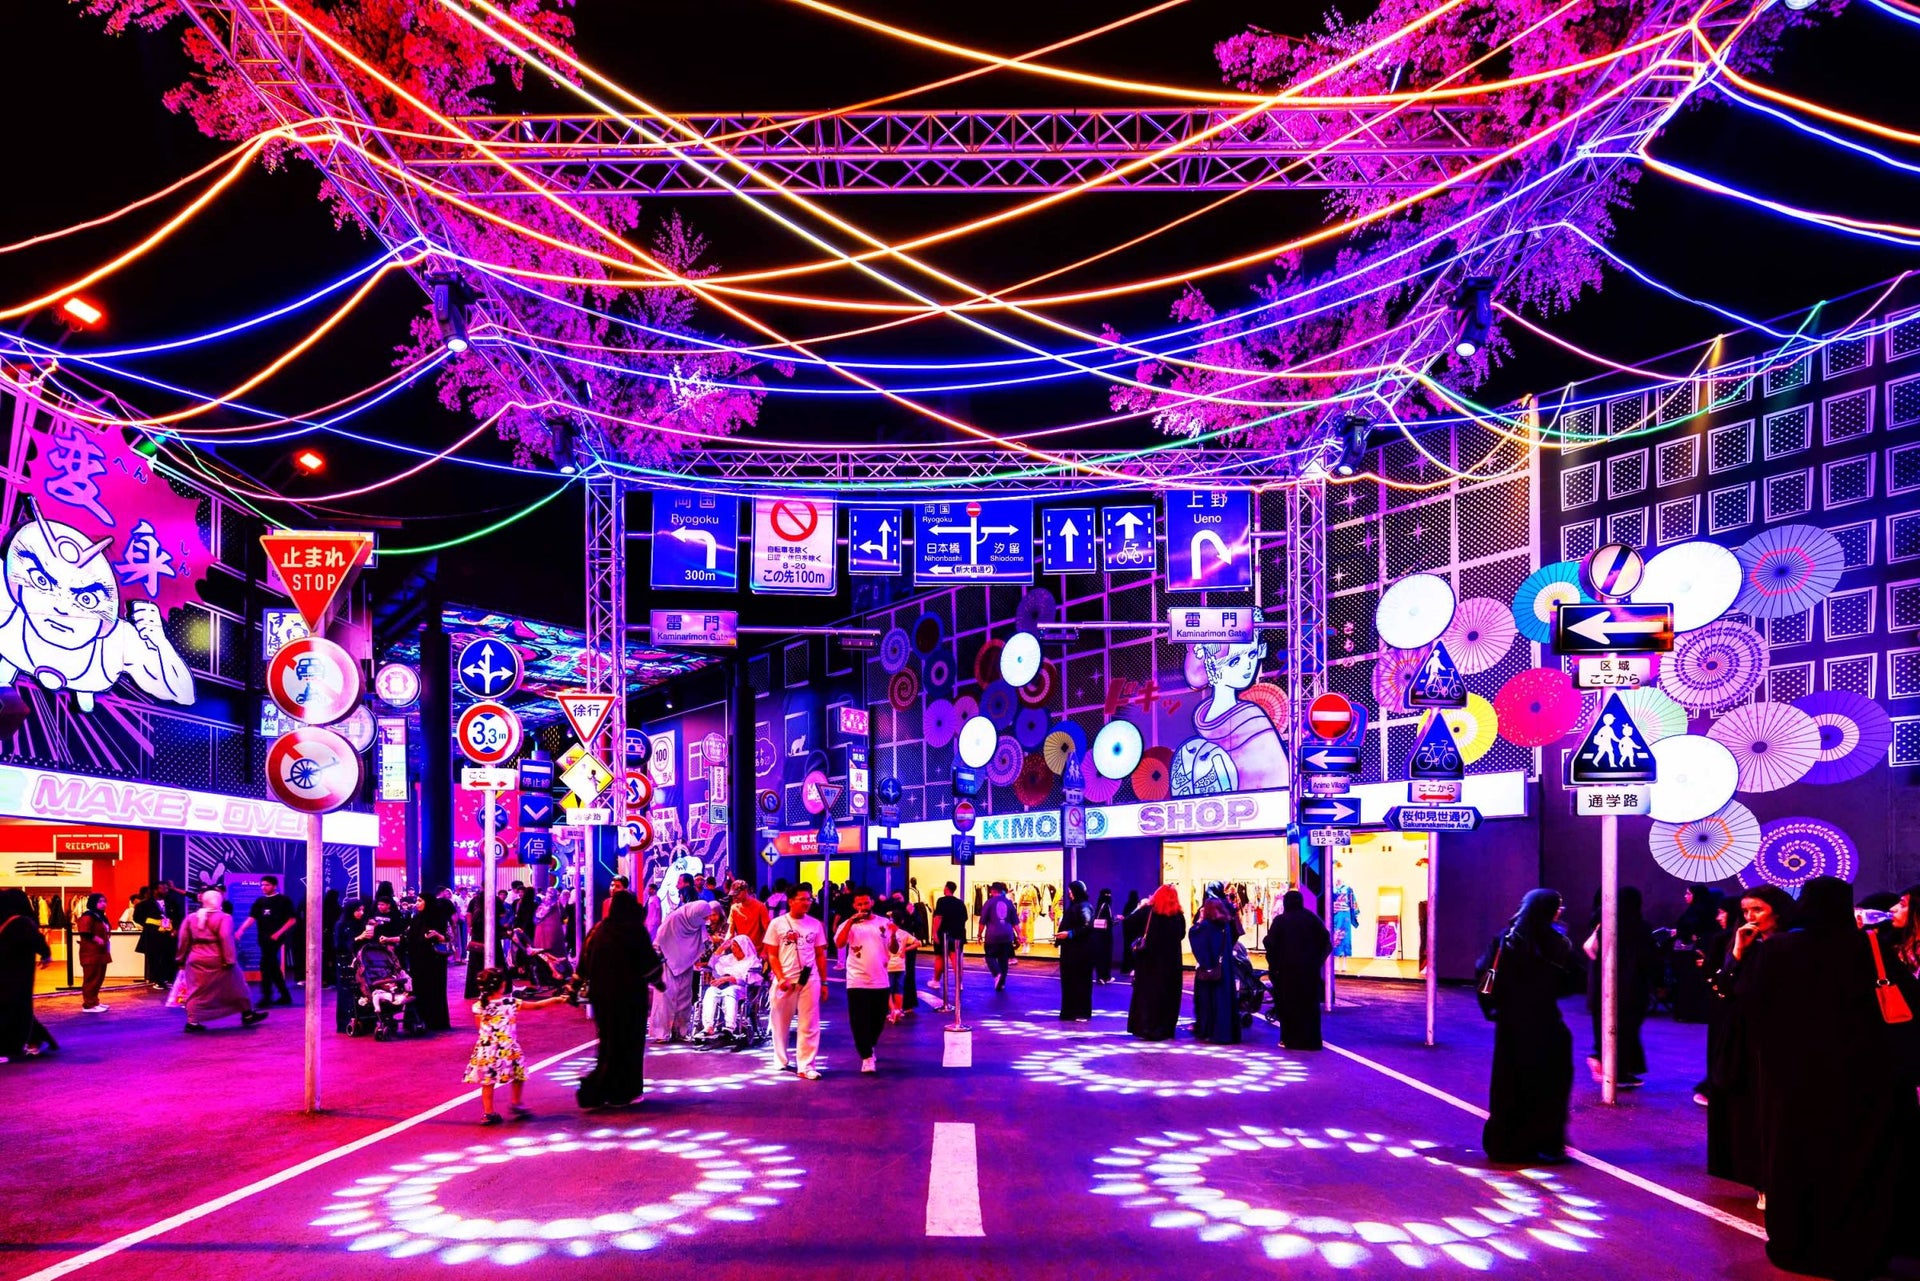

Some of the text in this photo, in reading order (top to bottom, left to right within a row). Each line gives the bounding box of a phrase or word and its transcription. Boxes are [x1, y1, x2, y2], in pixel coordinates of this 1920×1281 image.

[671, 513, 719, 525] Ryogoku
[1193, 514, 1222, 524] Ueno
[926, 542, 960, 554] 日本橋
[993, 542, 1020, 554] 汐留
[281, 546, 346, 568] 止まれ
[684, 569, 716, 581] 300m
[763, 570, 825, 583] この先100m
[292, 573, 337, 591] STOP
[666, 615, 720, 631] 雷門
[1185, 612, 1238, 628] 雷門
[657, 632, 708, 641] Kaminarimon
[1176, 629, 1247, 638] Kaminarimon Gate
[1600, 660, 1630, 671] 区域
[1590, 673, 1641, 685] ここから
[573, 704, 601, 717] 徐行
[655, 748, 668, 762] 100
[1419, 784, 1456, 793] ここから
[31, 774, 191, 827] MAKE
[221, 798, 307, 837] OVE
[1588, 794, 1639, 808] 通学路
[982, 810, 1107, 841] KIMOO
[1139, 798, 1257, 833] SHOP
[1402, 810, 1471, 822] 桜仲見世通り
[65, 842, 111, 850] RECEPTION
[523, 838, 547, 860] 停
[957, 839, 971, 861] 停
